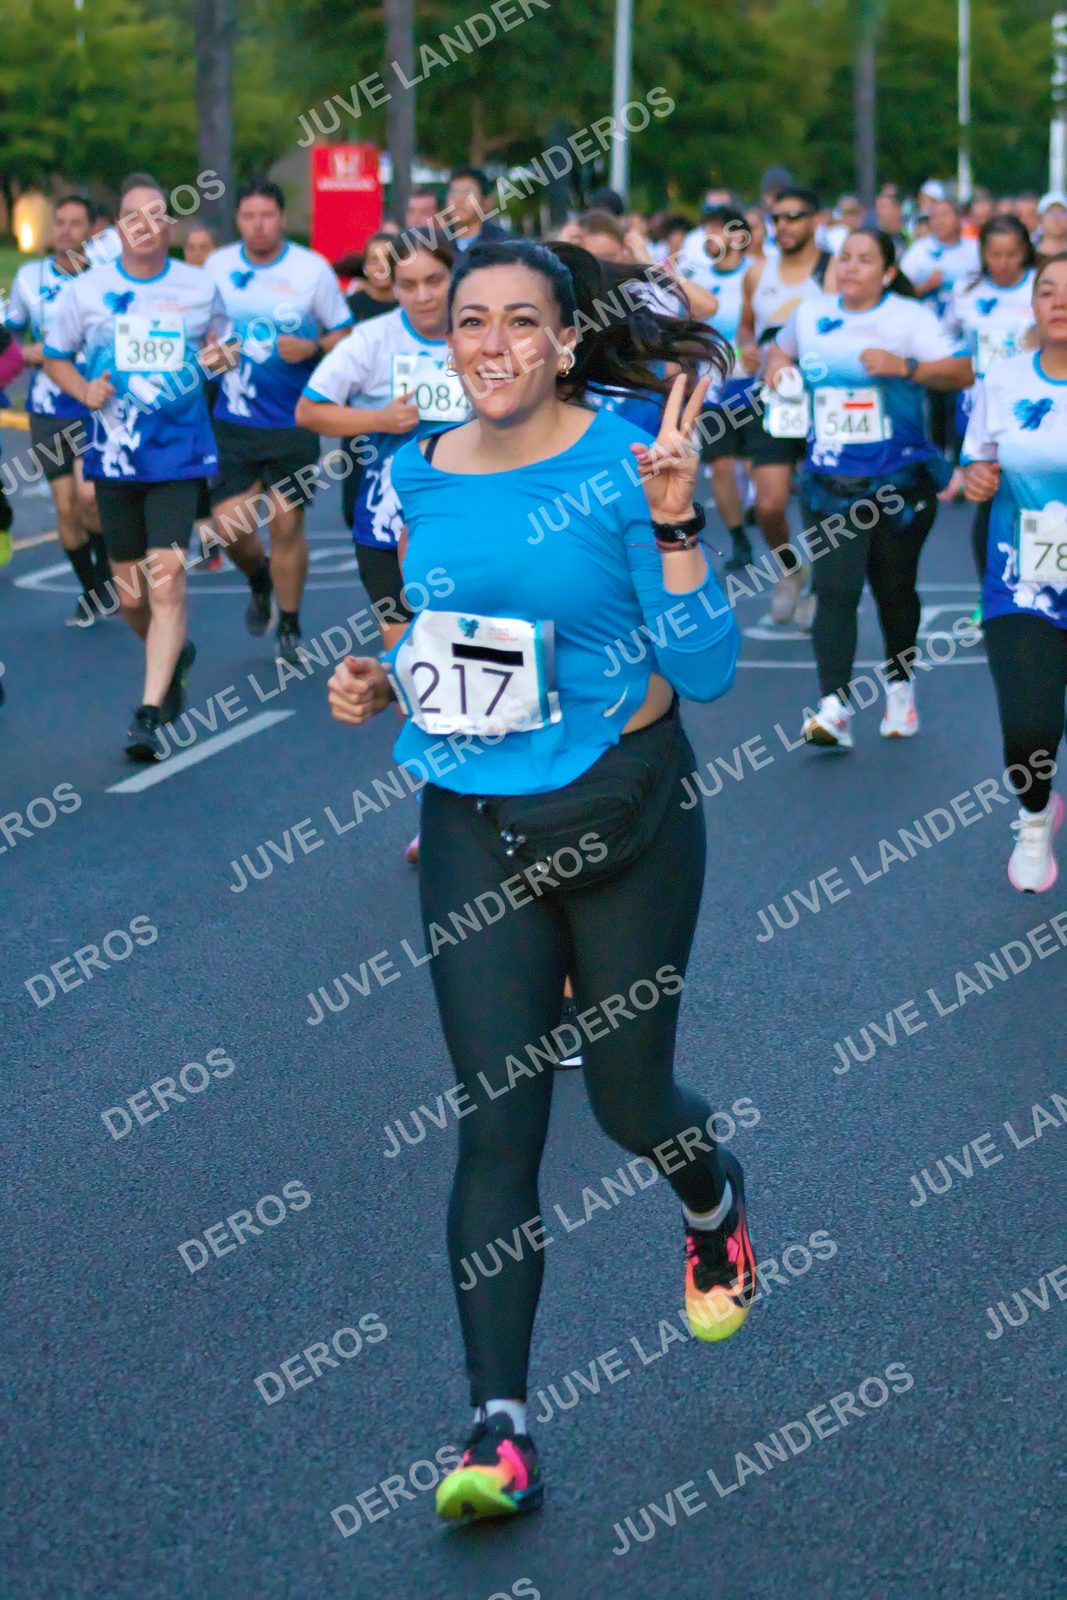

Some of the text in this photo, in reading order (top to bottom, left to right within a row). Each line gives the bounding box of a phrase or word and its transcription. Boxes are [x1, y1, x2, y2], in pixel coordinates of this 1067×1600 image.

[127, 340, 175, 364] 389
[823, 411, 871, 436] 544
[410, 661, 514, 717] 217
